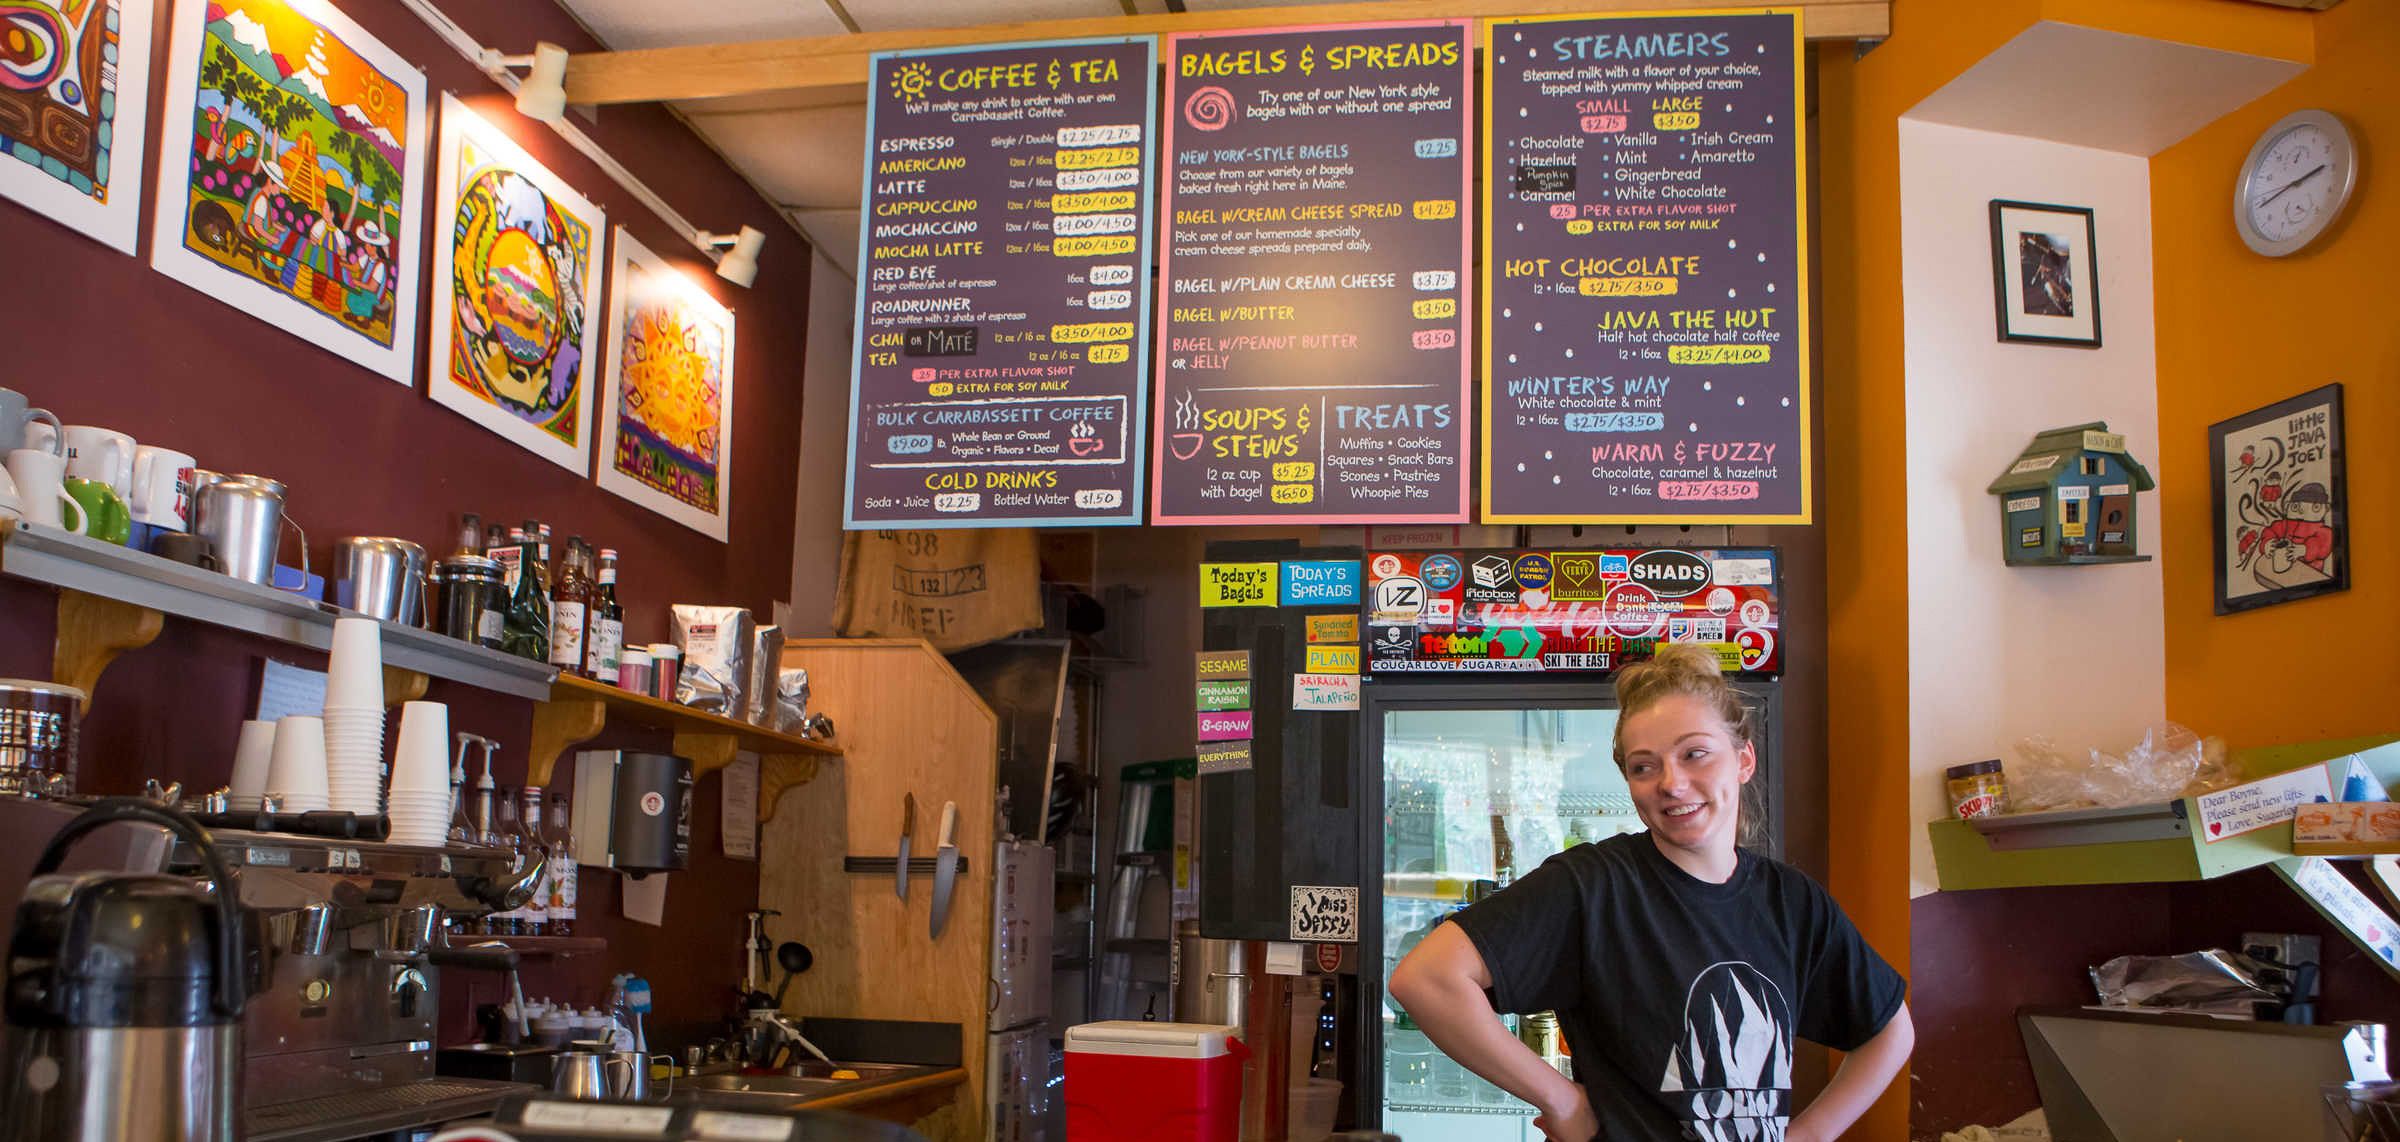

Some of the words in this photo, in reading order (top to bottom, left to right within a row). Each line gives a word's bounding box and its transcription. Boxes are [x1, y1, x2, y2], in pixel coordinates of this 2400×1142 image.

[1554, 33, 1730, 60] STEAMERS
[1181, 50, 1287, 77] BAGELS
[1300, 44, 1314, 75] &
[1326, 42, 1458, 70] SPREADS
[939, 63, 1037, 91] COFFEE
[1048, 59, 1060, 90] &
[1071, 59, 1119, 83] TEA
[1576, 100, 1631, 114] SMALL
[1653, 97, 1702, 111] LARGE
[952, 108, 1024, 122] Carrabassett
[1028, 108, 1066, 118] Coffee.
[881, 137, 954, 153] ESPRESSO
[1520, 136, 1584, 149] Chocolate
[1615, 134, 1656, 146] Vanilla
[1691, 133, 1722, 145] Irish
[1729, 132, 1773, 144] Cream
[1180, 151, 1207, 164] NEW
[1214, 147, 1294, 162] YORK-STYLE
[1300, 145, 1348, 159] BAGELS
[1521, 154, 1576, 167] Hazelnut
[1616, 152, 1647, 164] Mint
[1691, 150, 1754, 162] Amaretto
[879, 157, 966, 174] AMERICANO
[1615, 169, 1701, 182] Gingerbread
[878, 180, 926, 194] LATTE
[1615, 187, 1655, 199] White
[1662, 185, 1726, 198] Chocolate
[1521, 190, 1575, 202] Caramel
[877, 200, 977, 217] CAPPUCCINO
[1177, 210, 1216, 224] BAGEL
[1222, 207, 1286, 222] W/CREAM
[1291, 205, 1344, 220] CHEESE
[1350, 204, 1401, 219] SPREAD
[876, 221, 977, 237] MOCHACCINO
[875, 244, 929, 260] MOCHA
[935, 242, 983, 257] LATTE
[874, 267, 903, 280] RED
[909, 266, 936, 279] EYE
[1505, 259, 1550, 278] HOT
[1560, 256, 1700, 277] CHOCOLATE
[1175, 278, 1216, 293] BAGEL
[1221, 277, 1280, 292] W/PLAIN
[1285, 275, 1336, 290] CREAM
[1341, 273, 1395, 288] CHEESE
[872, 298, 970, 313] ROADRUNNER
[1174, 308, 1215, 322] BAGEL
[1220, 305, 1294, 321] W/BUTTER
[1598, 310, 1660, 329] JAVA
[1670, 310, 1715, 328] THE
[1726, 308, 1776, 328] HUT
[870, 334, 904, 347] CHAI
[928, 329, 974, 353] MATÉ
[1173, 338, 1214, 351] BAGEL
[1219, 336, 1297, 351] W/PEANUT
[1303, 335, 1358, 348] BUTTER
[1598, 331, 1624, 343] Half
[1628, 331, 1647, 343] hot
[1653, 330, 1709, 342] chocolate
[1714, 330, 1738, 341] half
[1742, 330, 1780, 342] coffee
[869, 353, 897, 366] TEA
[1093, 349, 1120, 360] $1.75
[1173, 359, 1186, 369] OR
[1190, 355, 1229, 370] JELLY
[1508, 377, 1615, 397] WINTER'S
[1625, 376, 1670, 397] WAY
[1519, 397, 1555, 408] White
[1560, 397, 1616, 408] chocolate
[1622, 397, 1629, 407] &
[1635, 397, 1661, 407] mint
[877, 411, 914, 426] BULK
[923, 409, 1042, 424] CARRABASSETT
[1050, 407, 1114, 421] COFFEE
[1203, 408, 1287, 431] SOUPS
[1297, 404, 1311, 434] &
[1336, 404, 1451, 430] TREATS
[2289, 412, 2325, 433] little
[1213, 434, 1299, 458] STEWS
[1340, 438, 1383, 449] Muffins
[1397, 437, 1441, 449] Cookies
[2288, 429, 2326, 450] JAVA
[951, 445, 984, 458] Organic
[994, 445, 1024, 455] Flavors
[1034, 444, 1059, 454] Decaf
[1592, 443, 1663, 463] WARM
[1675, 441, 1687, 466] &
[1696, 442, 1776, 463] FUZZY
[2288, 446, 2325, 468] JOEY
[1328, 455, 1374, 467] Squares
[1388, 454, 1423, 464] Snack
[1428, 454, 1453, 464] Bars
[925, 472, 977, 489] COLD
[986, 471, 1057, 488] DRINKS
[1340, 470, 1379, 482] Scones
[1394, 470, 1440, 481] Pastries
[1592, 467, 1653, 480] Chocolate,
[1660, 467, 1708, 479] caramel
[1714, 468, 1721, 478] &
[1727, 467, 1777, 478] hazelnut
[994, 494, 1032, 506] Bottled
[1035, 494, 1069, 505] Water
[1201, 487, 1225, 498] with
[1229, 487, 1262, 501] bagel
[1351, 487, 1401, 500] Whoopie
[1405, 487, 1429, 497] Pies
[865, 497, 891, 508] Soda
[904, 496, 929, 507] Juice
[1211, 568, 1267, 586] Today's
[1289, 565, 1346, 581] TODAY'S
[1634, 565, 1705, 580] SHADS
[921, 580, 940, 592] 132
[1291, 583, 1352, 599] SPREADS
[1558, 588, 1599, 597] burritos
[1221, 585, 1263, 603] Bagels
[1466, 590, 1516, 598] indobox
[1618, 594, 1646, 602] Drink
[1613, 612, 1649, 620] Coffee
[1587, 636, 1616, 652] THE
[1200, 659, 1247, 673] SESAME
[1311, 653, 1355, 667] PLAIN
[1546, 655, 1560, 667] SKI
[1566, 655, 1581, 667] THE
[1586, 655, 1608, 667] EAST
[1199, 686, 1248, 695] CINNAMON
[1208, 695, 1239, 704] RAISIN
[1202, 719, 1249, 731] 8-GRAIN
[1200, 750, 1248, 763] EVERYTHING
[1308, 892, 1316, 907] I
[1318, 896, 1347, 913] Miss
[1300, 905, 1350, 934] Jerry
